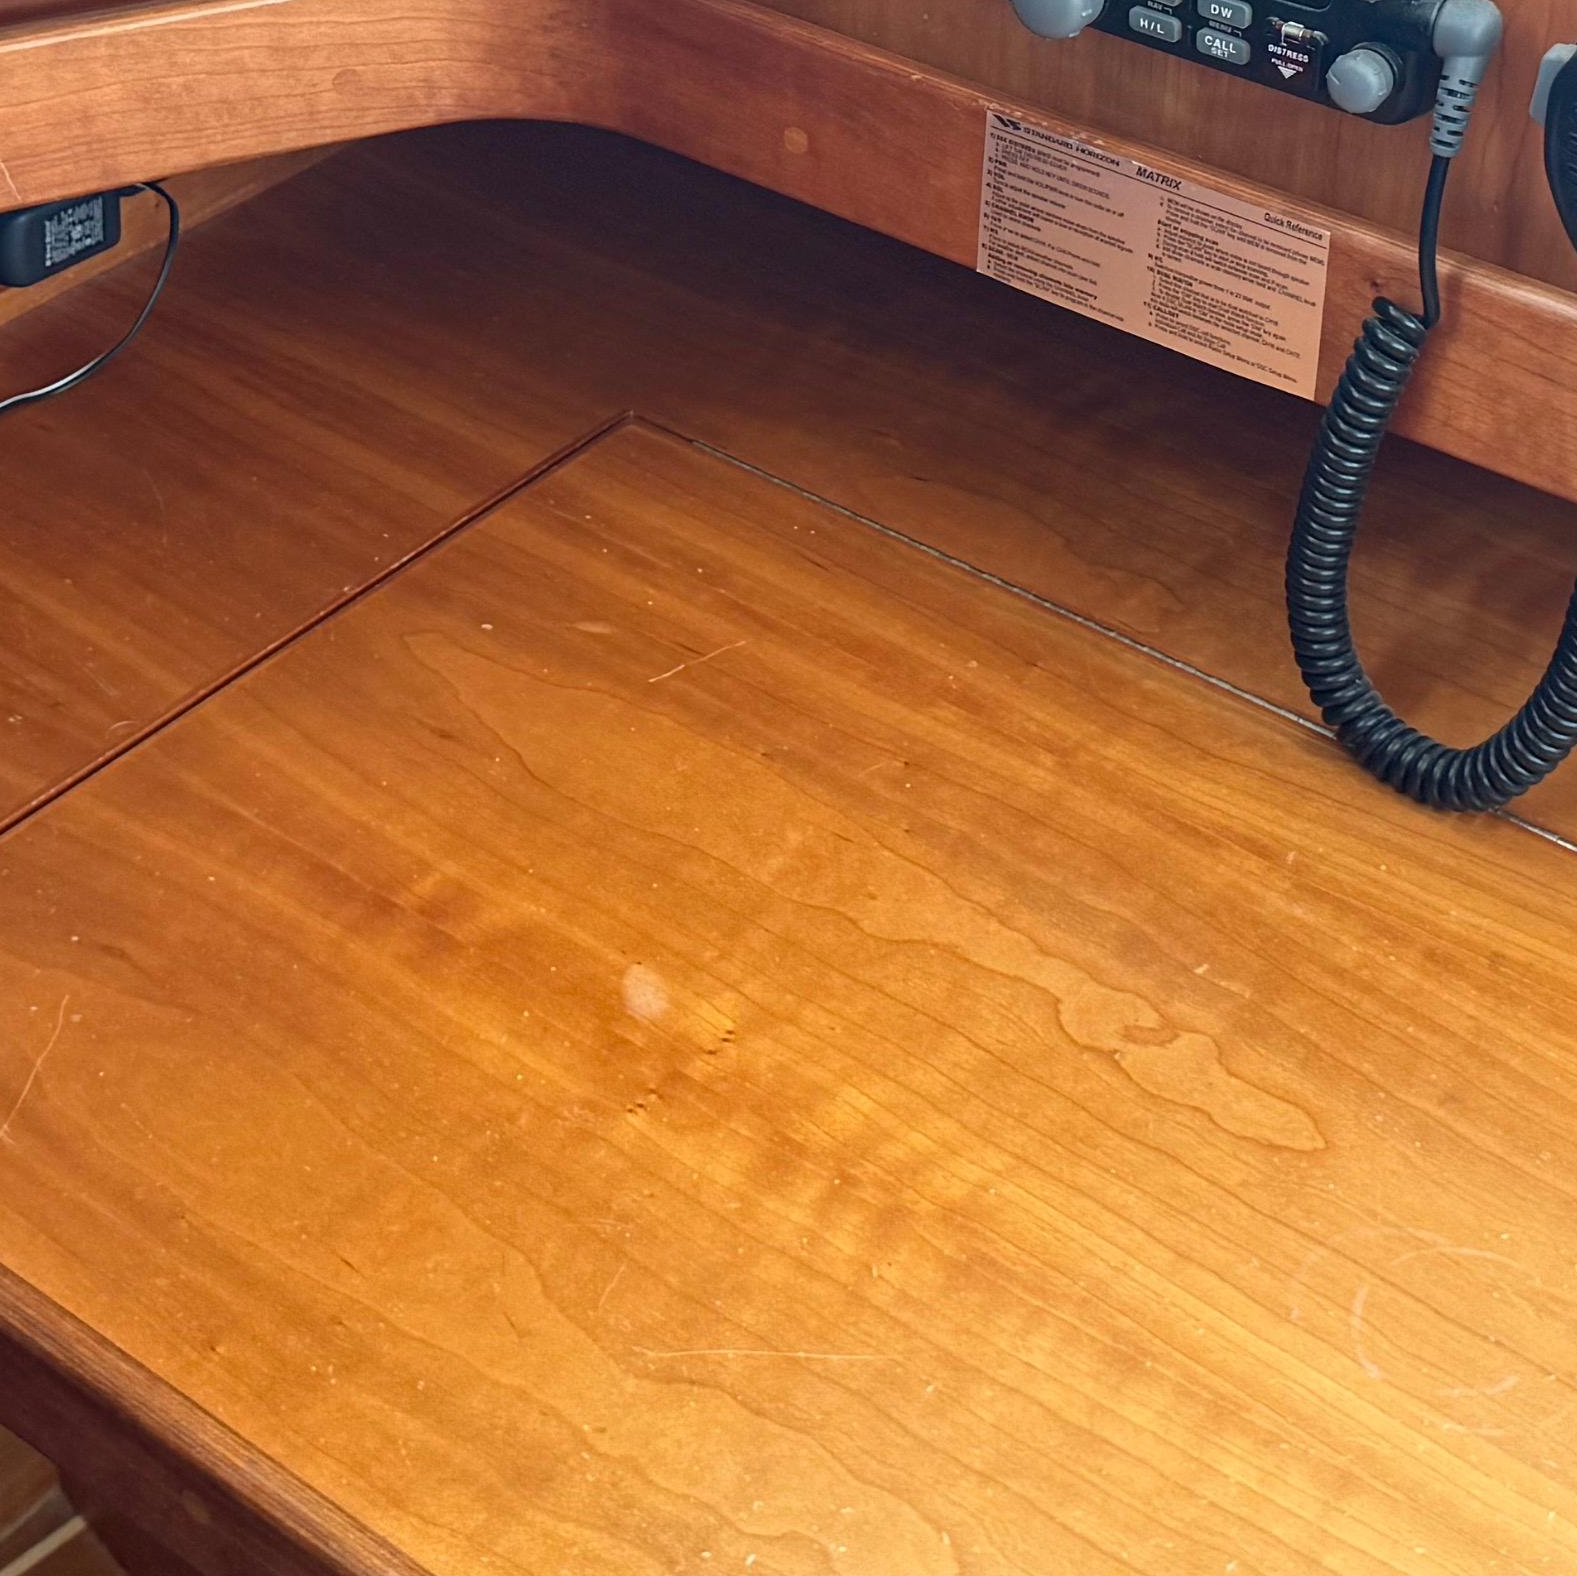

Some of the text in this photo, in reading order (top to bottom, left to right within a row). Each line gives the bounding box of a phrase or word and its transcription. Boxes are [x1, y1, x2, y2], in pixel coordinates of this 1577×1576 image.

[1210, 4, 1233, 18] DW
[1139, 18, 1165, 35] H/L
[1204, 35, 1237, 54] CALL
[1211, 47, 1229, 58] SET
[1267, 44, 1309, 63] DISTRESS
[1076, 143, 1120, 168] HORIZON
[1135, 166, 1183, 191] MATRIX
[1264, 212, 1286, 227] Quick
[1286, 220, 1323, 241] Reference
